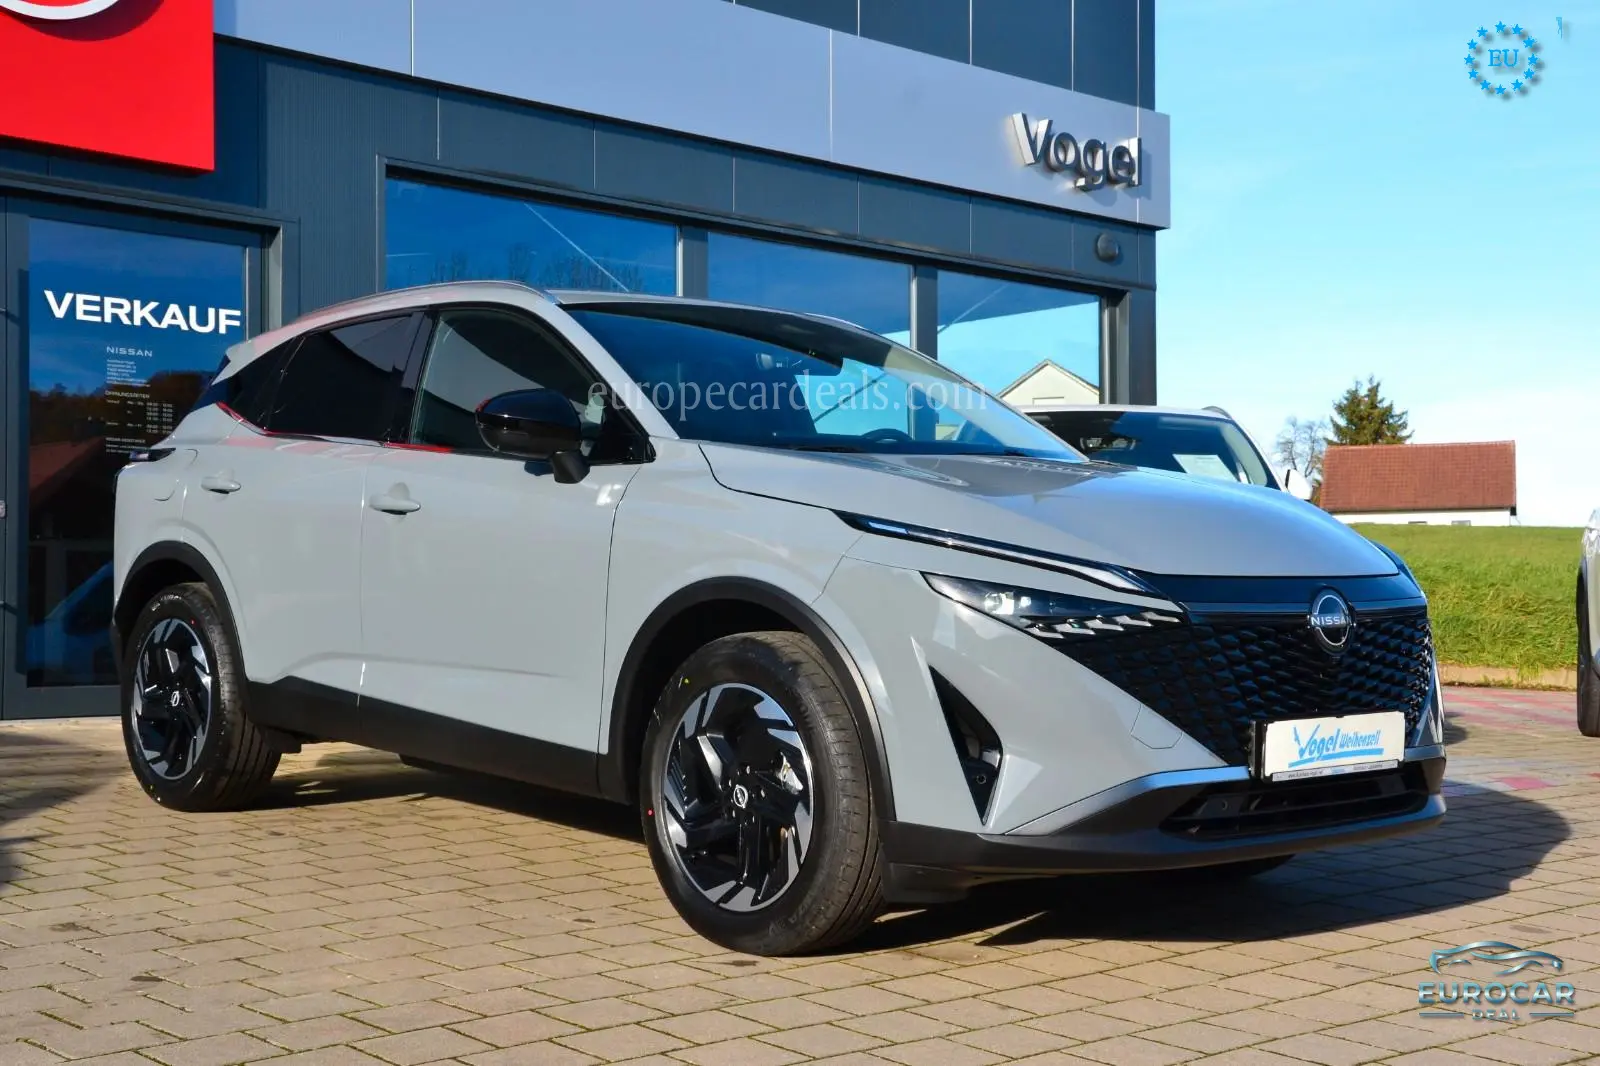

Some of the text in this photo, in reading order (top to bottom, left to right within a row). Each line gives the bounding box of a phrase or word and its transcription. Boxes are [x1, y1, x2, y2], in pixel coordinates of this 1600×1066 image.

[1012, 112, 1142, 192] Vogel
[44, 289, 241, 334] VERKAUF
[106, 346, 153, 358] NISSAN
[1293, 723, 1340, 760] Vogel
